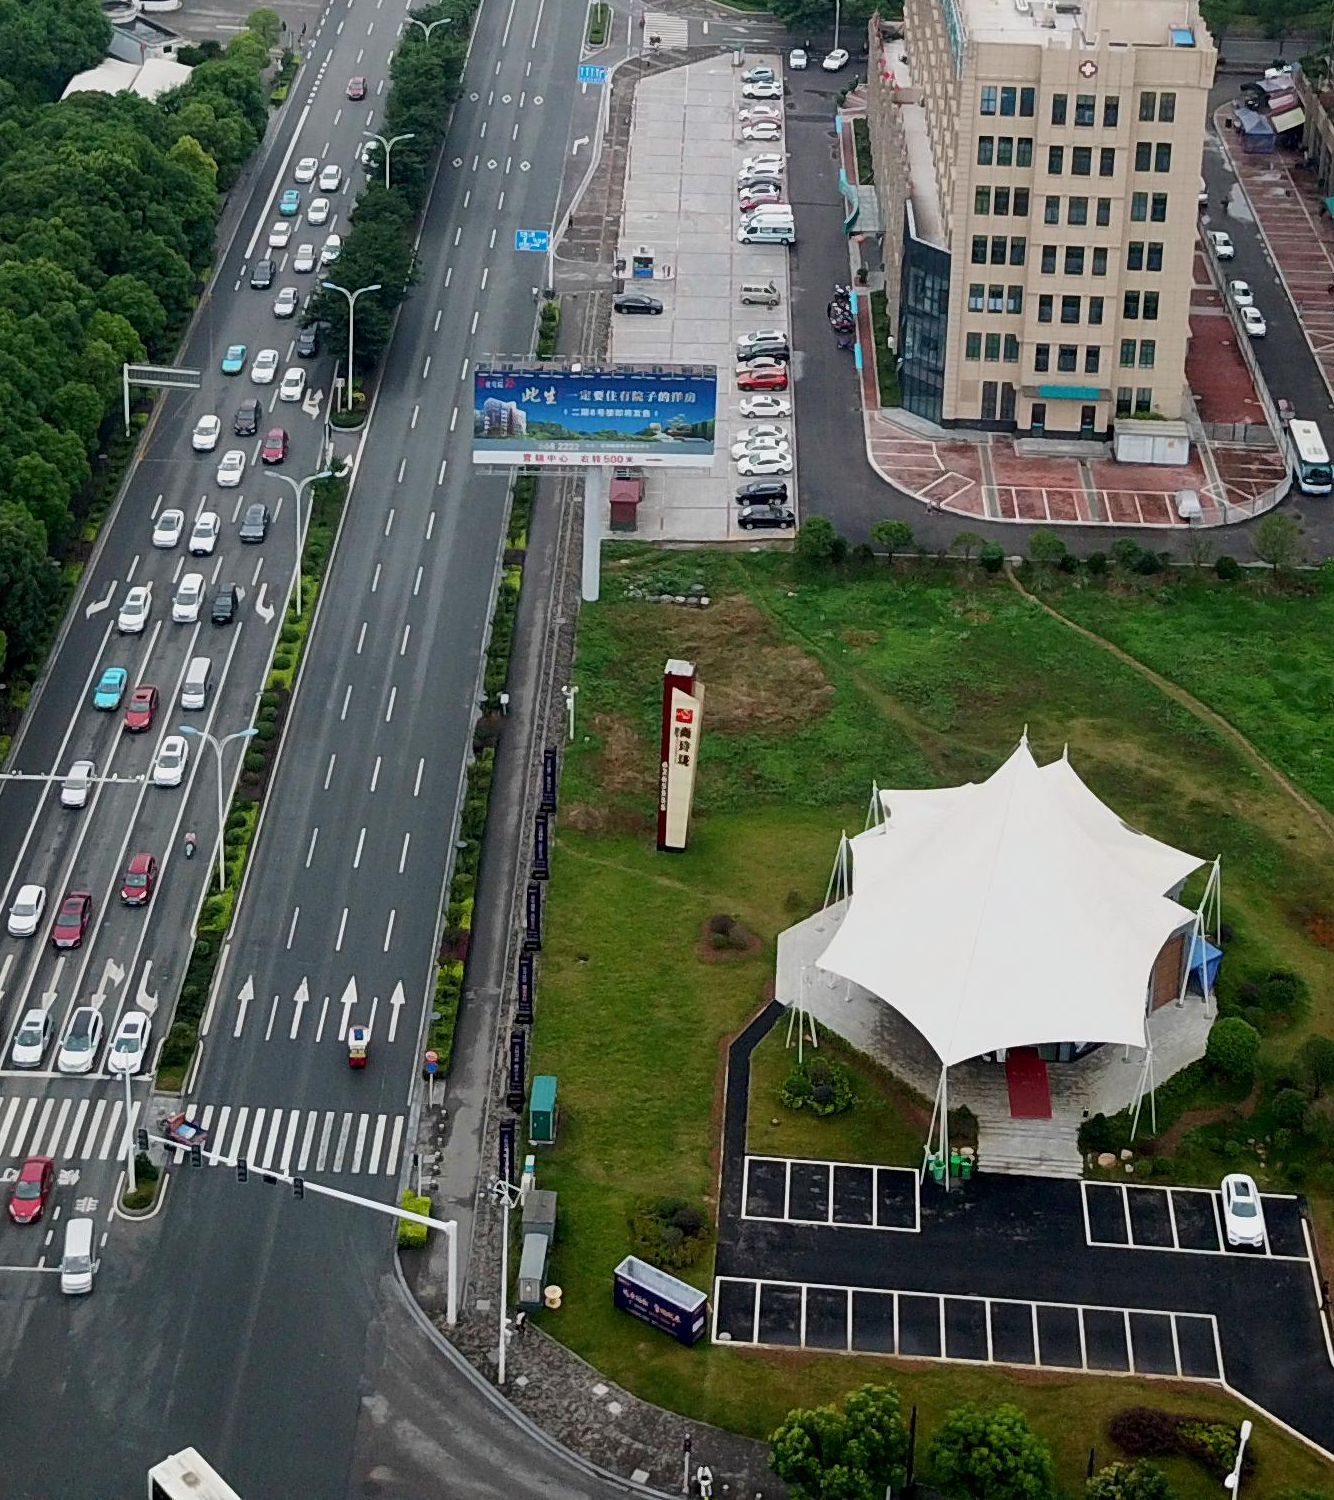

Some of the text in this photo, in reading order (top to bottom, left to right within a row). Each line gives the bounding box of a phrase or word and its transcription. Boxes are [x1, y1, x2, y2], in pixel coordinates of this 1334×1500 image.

[522, 386, 557, 404] 此生
[523, 453, 568, 463] 营销中心
